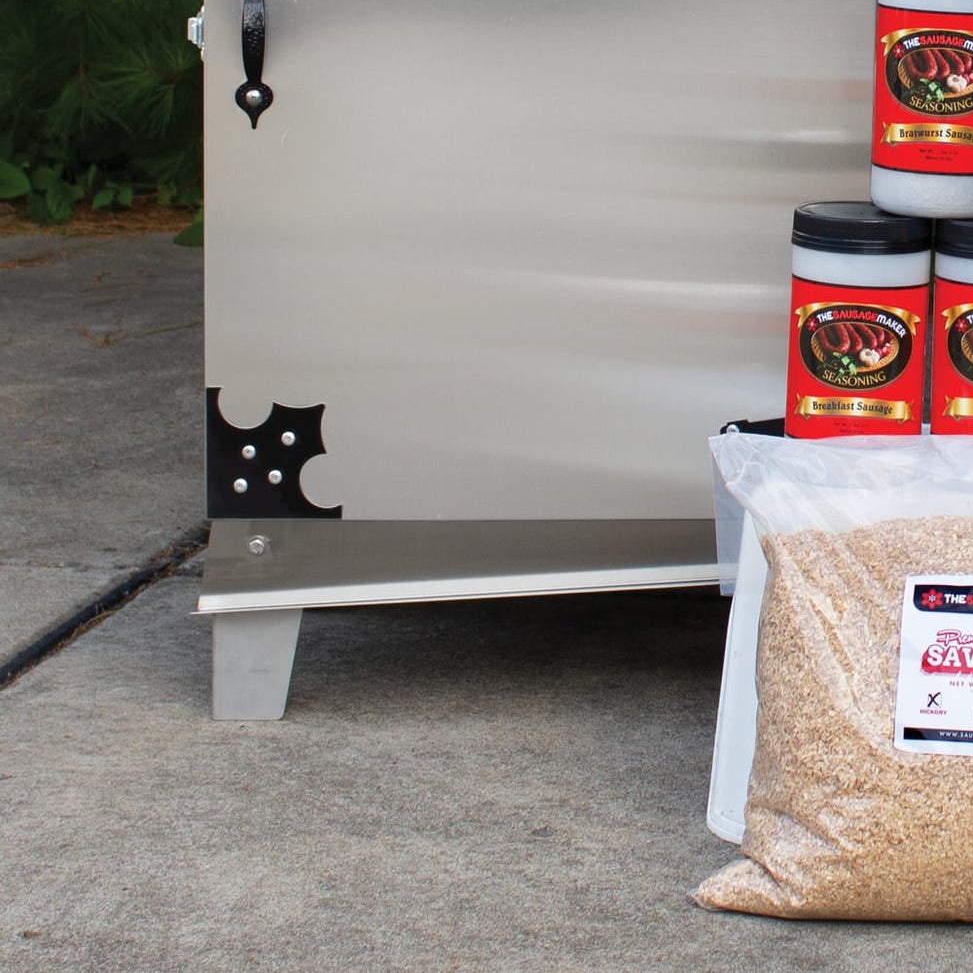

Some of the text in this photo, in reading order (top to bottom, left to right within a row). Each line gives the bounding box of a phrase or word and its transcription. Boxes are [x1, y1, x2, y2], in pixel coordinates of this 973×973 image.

[908, 95, 973, 113] SEASONING
[899, 128, 943, 139] Bratwurst
[822, 370, 887, 388] SEASONING
[812, 401, 893, 415] Breakfast Sausage
[919, 708, 947, 716] HICKORY
